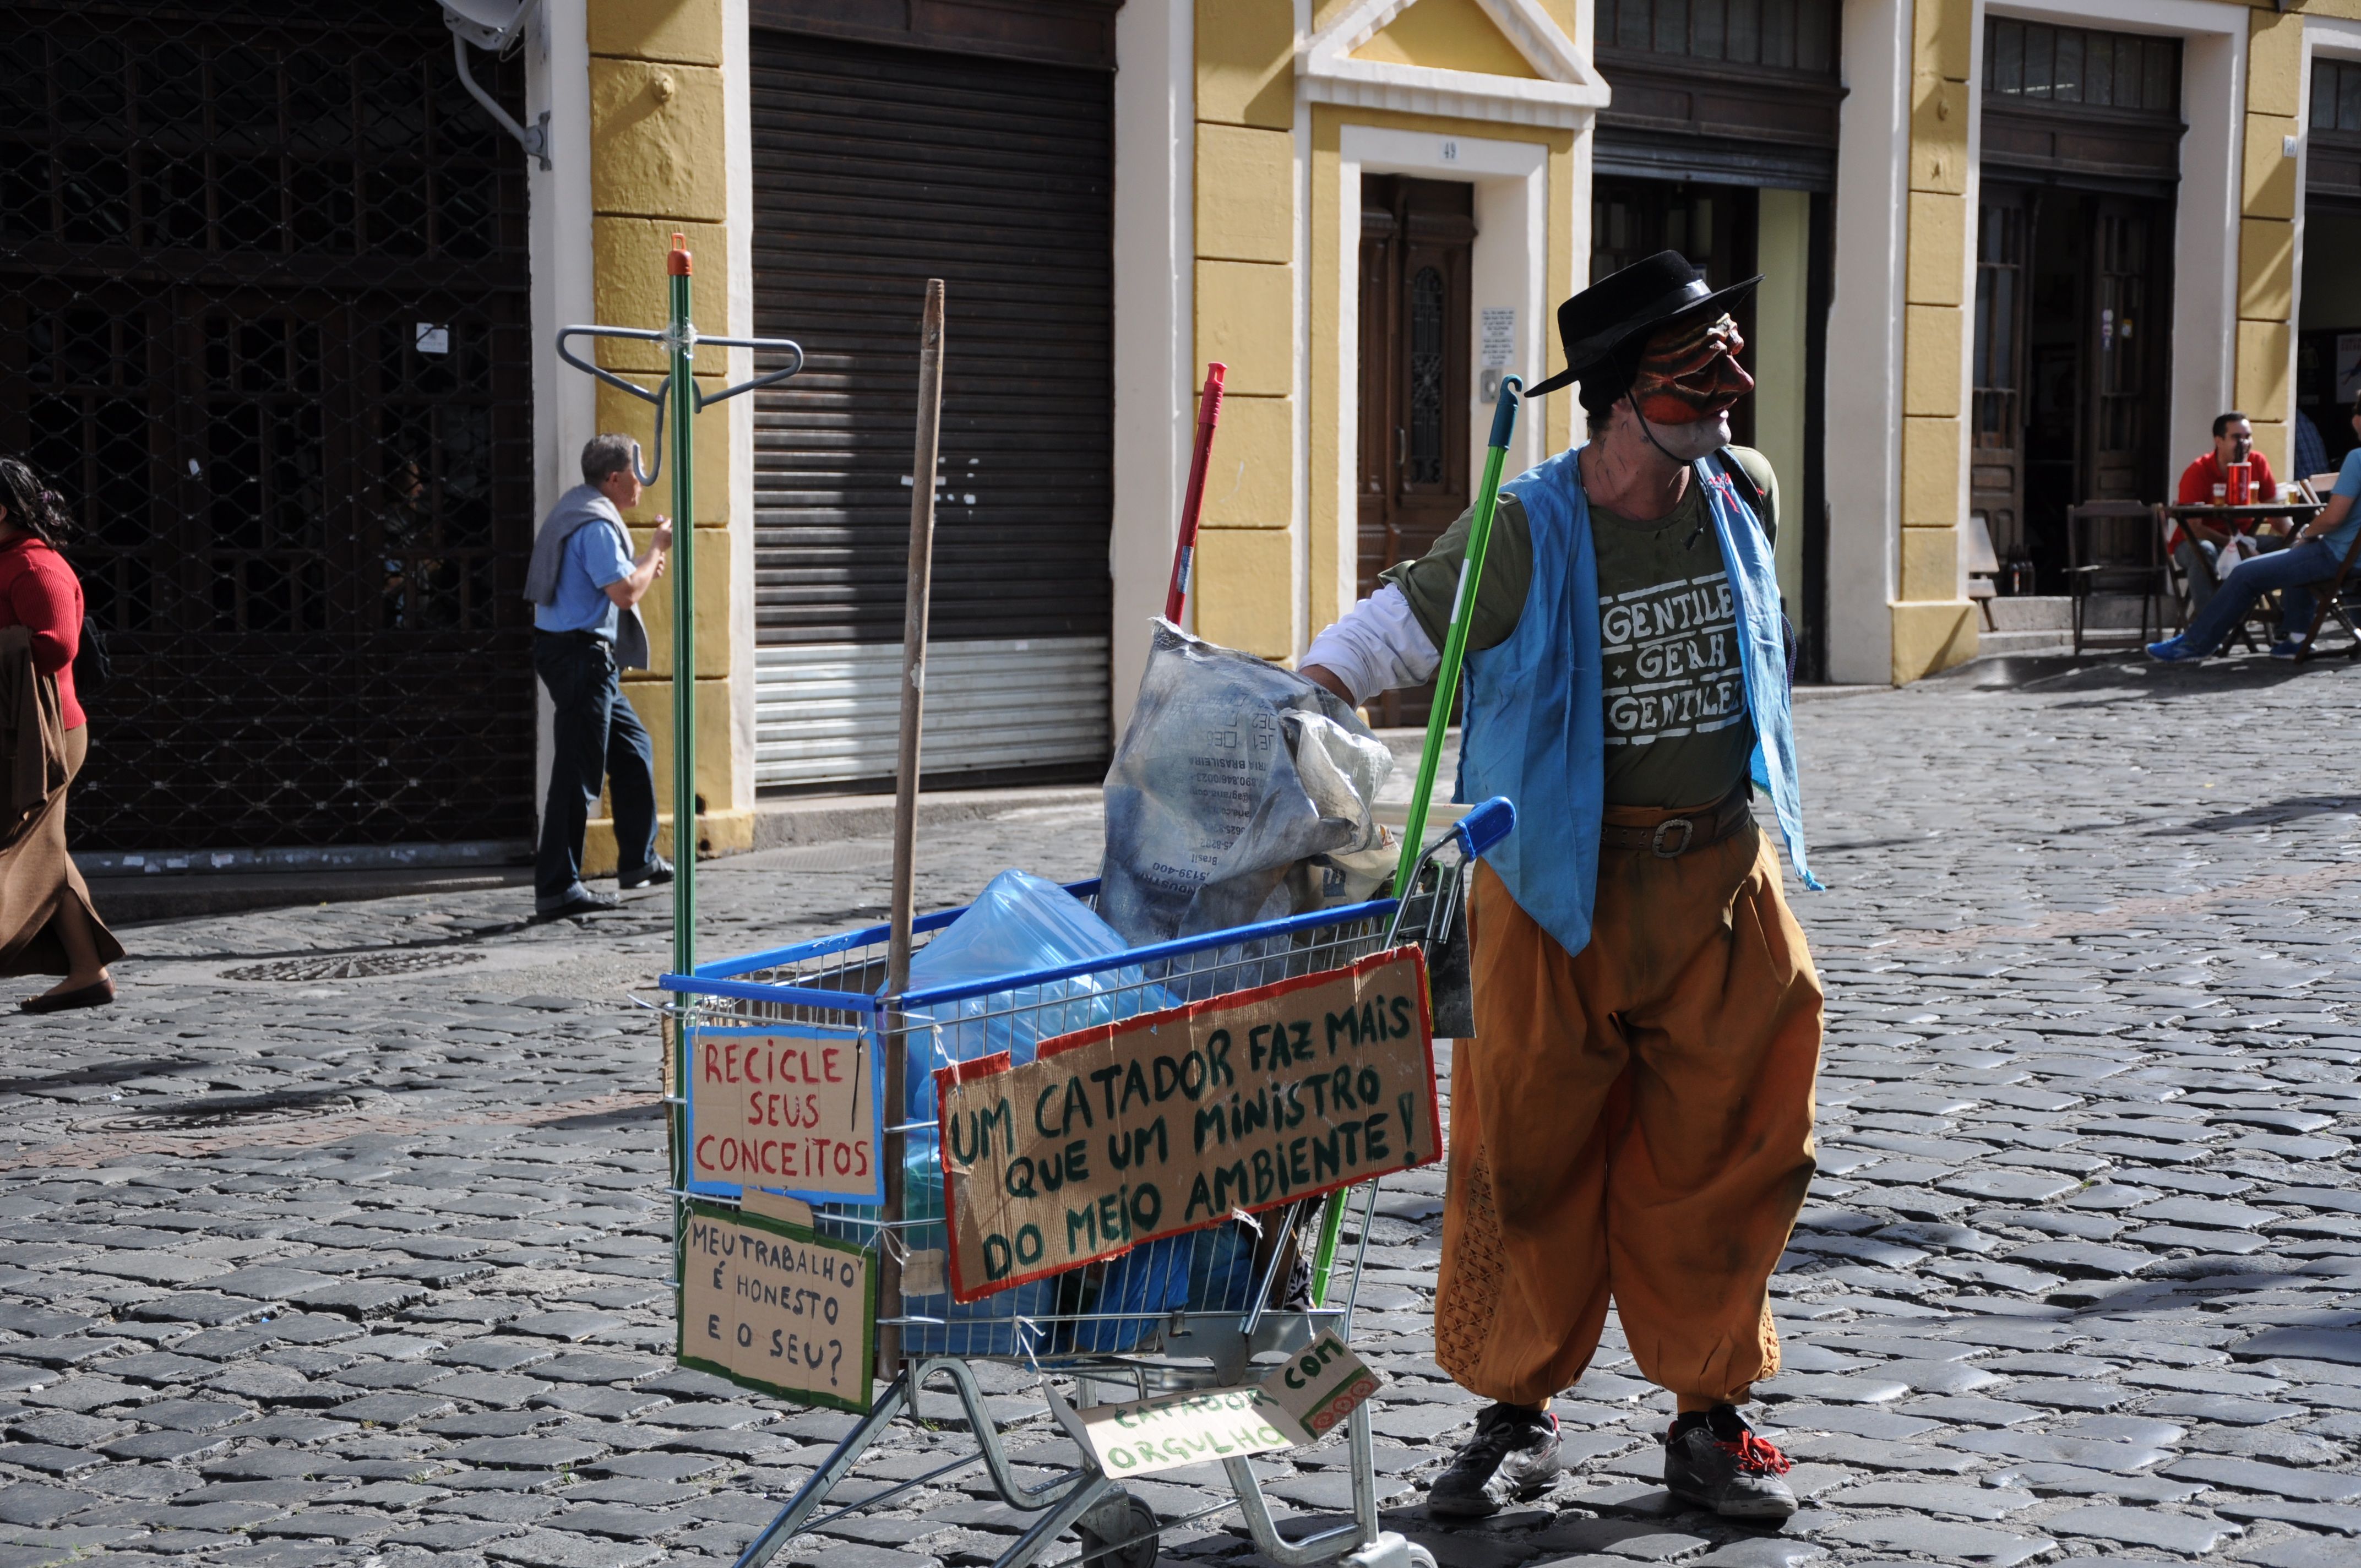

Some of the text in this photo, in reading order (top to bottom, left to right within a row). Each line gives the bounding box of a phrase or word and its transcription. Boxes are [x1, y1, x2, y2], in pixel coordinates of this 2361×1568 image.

[1188, 756, 1245, 770] BRASILEIRA
[1152, 862, 1210, 881] 5139-400
[1191, 854, 1217, 865] Brasil
[705, 1039, 842, 1084] RECICLE
[951, 994, 1413, 1167] UM CATADOR FAZ MAIS
[748, 1091, 819, 1129] SEUS
[1005, 1065, 1381, 1198] QUE UM MINISTRO
[696, 1134, 868, 1177] CONCEITOS
[982, 1223, 1044, 1281] DO
[1066, 1182, 1162, 1255] MEIO
[713, 1262, 839, 1326] É HONESTO
[708, 1315, 842, 1387] E O SEU?
[1114, 1387, 1280, 1429] CATADOR
[1107, 1425, 1287, 1469] ORGULHO
